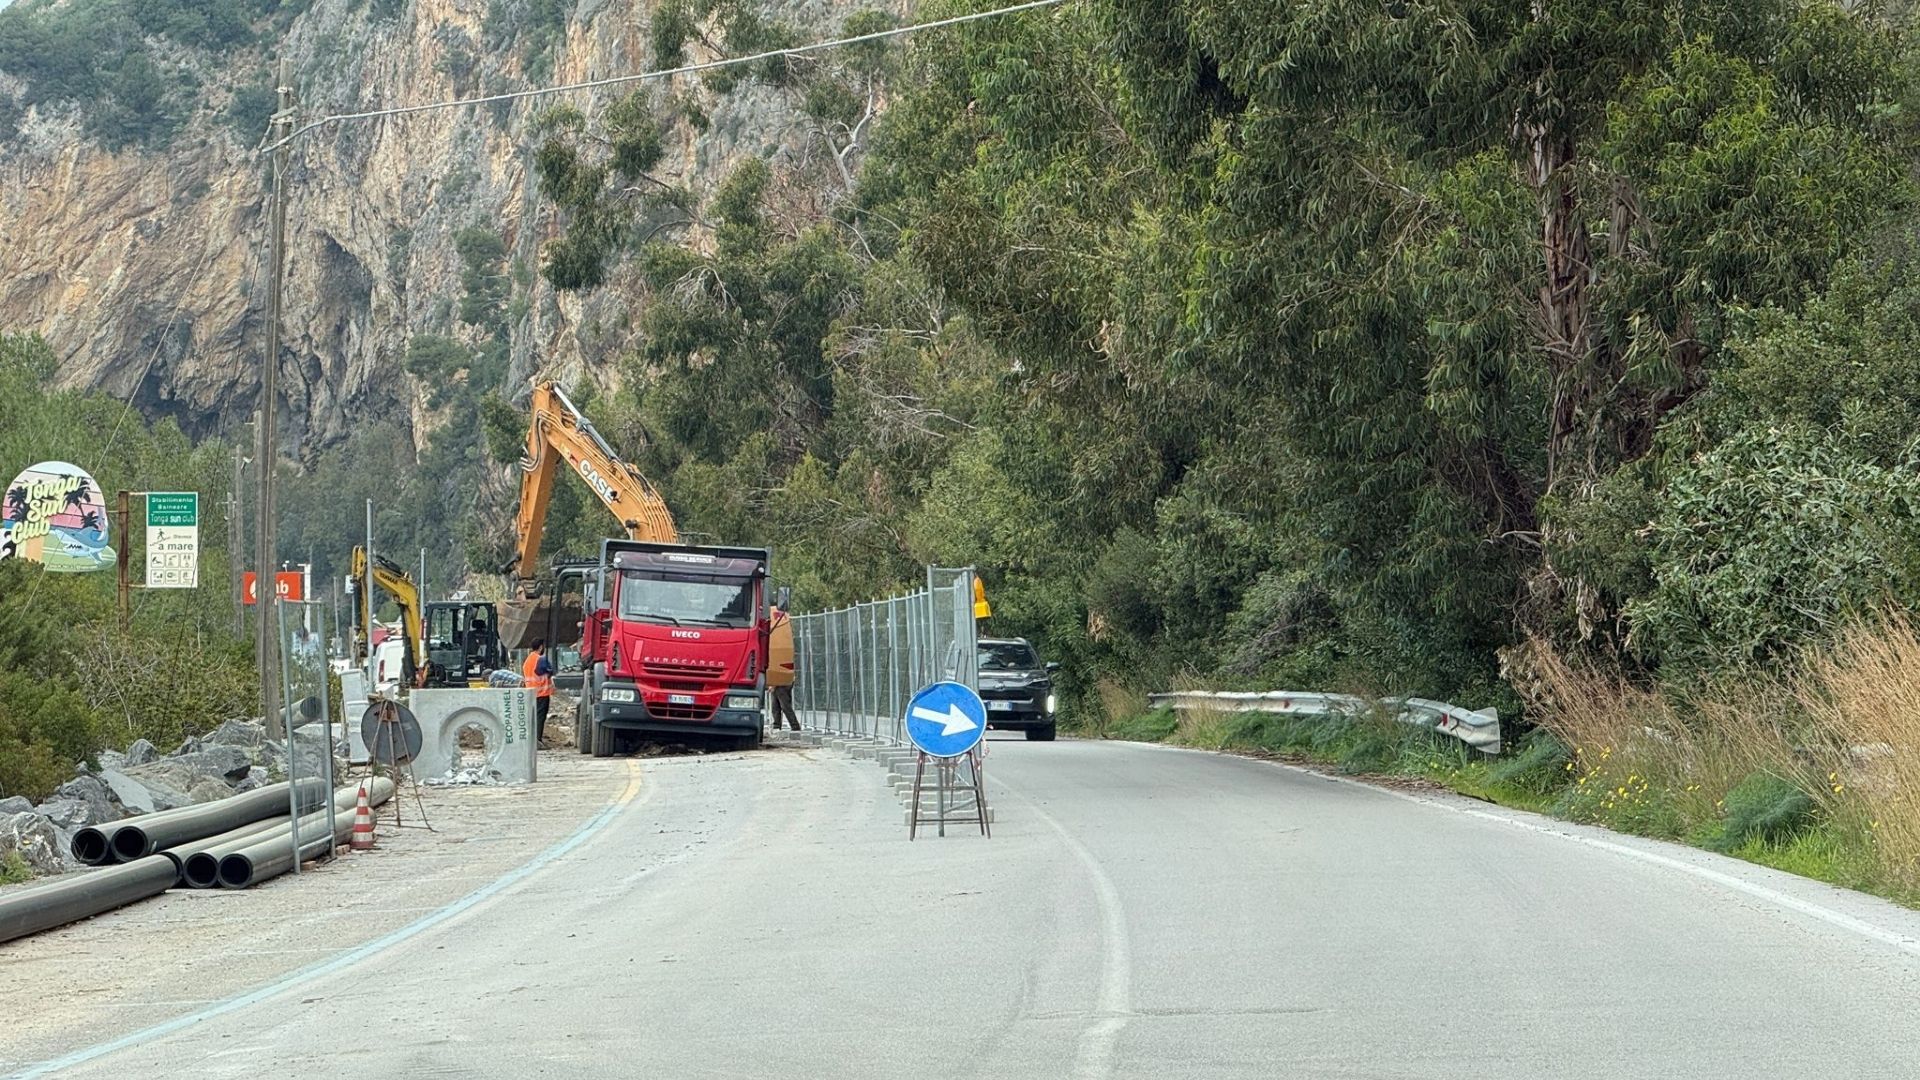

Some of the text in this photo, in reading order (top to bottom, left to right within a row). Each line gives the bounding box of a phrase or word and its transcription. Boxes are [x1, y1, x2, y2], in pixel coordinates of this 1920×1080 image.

[22, 476, 81, 504] Tonga
[27, 498, 68, 522] Sun
[151, 513, 195, 524] Tonga sun club
[11, 517, 50, 544] Club
[671, 630, 700, 639] IVECO
[644, 656, 725, 667] EUROCARGO
[503, 689, 513, 745] ECOPANNEL
[517, 691, 527, 740] RUGGIERO
